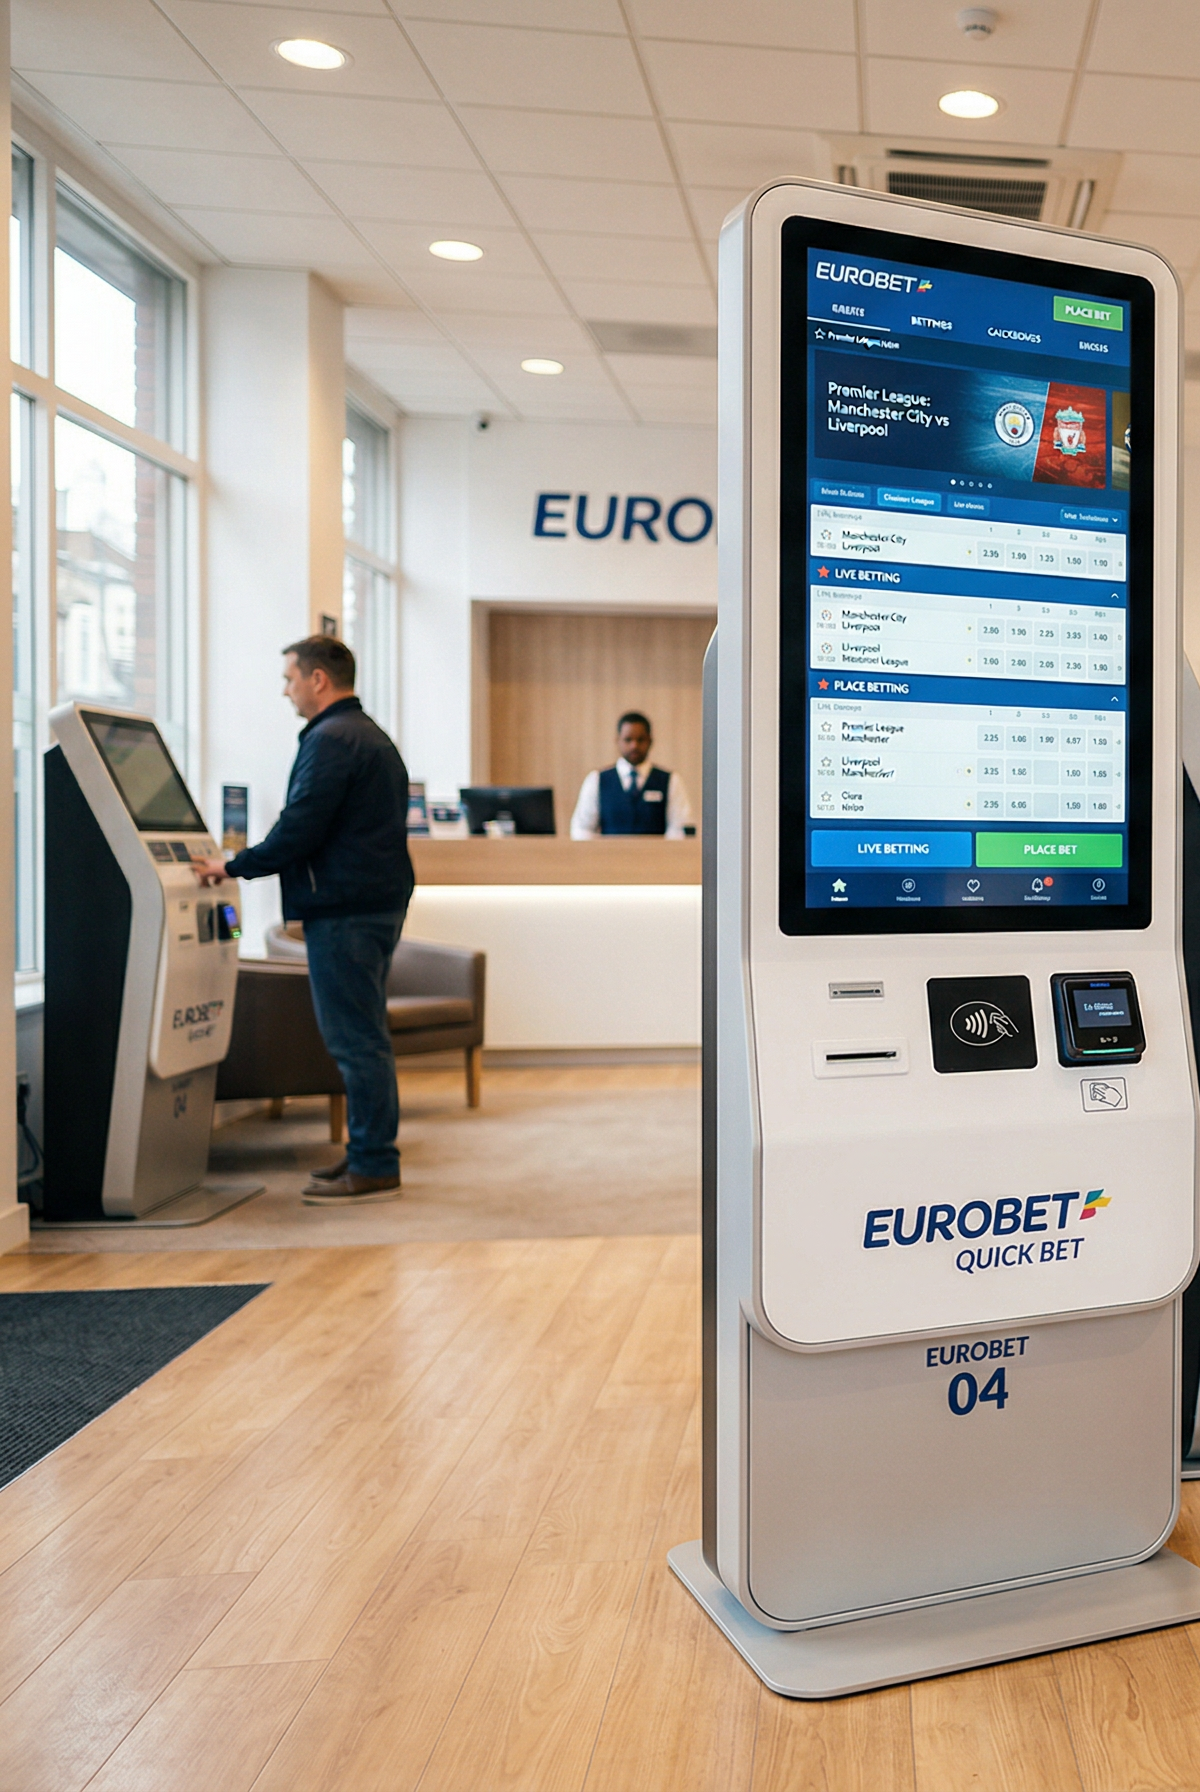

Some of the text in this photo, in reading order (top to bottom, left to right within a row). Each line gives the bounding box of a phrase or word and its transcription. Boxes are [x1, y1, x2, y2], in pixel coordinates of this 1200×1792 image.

[815, 261, 917, 293] EUROBET
[882, 388, 931, 407] League:
[828, 400, 950, 428] Manchester City vs
[828, 417, 888, 437] Liverpool
[534, 493, 717, 543] EURO
[835, 568, 901, 584] LIVE BETTING
[834, 680, 909, 694] PLACE BETTING
[857, 843, 930, 855] LIVE BETTING
[1024, 845, 1077, 855] PLACE BET
[863, 1191, 1080, 1249] EUROBET
[956, 1238, 1085, 1274] QUICK BET
[926, 1336, 1030, 1368] EUROBET
[948, 1367, 1009, 1416] 04
